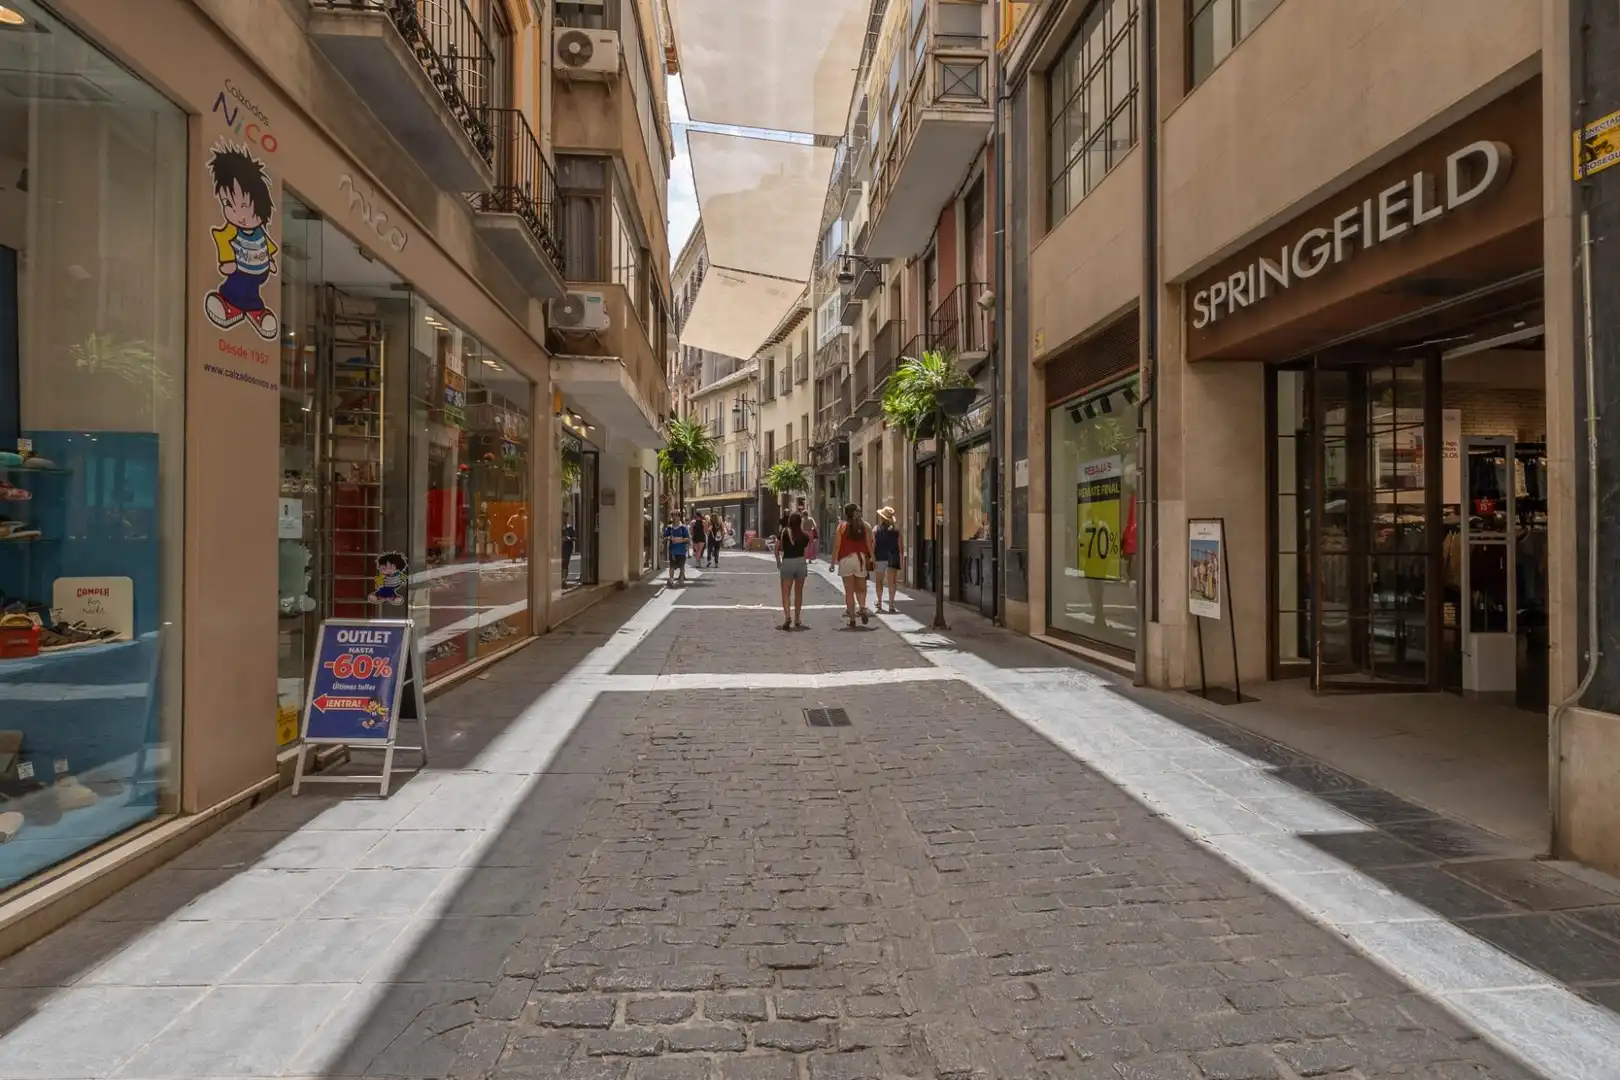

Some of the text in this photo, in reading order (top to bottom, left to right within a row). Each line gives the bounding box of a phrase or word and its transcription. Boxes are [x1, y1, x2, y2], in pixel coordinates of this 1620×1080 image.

[223, 78, 269, 127] Calzados
[1193, 140, 1512, 330] SPRINGFIELD
[218, 338, 248, 358] Desde
[1084, 462, 1113, 477] REBAJAS
[1101, 483, 1120, 495] FINAL
[1079, 526, 1119, 560] -70%
[76, 587, 110, 598] CAMPER
[336, 630, 392, 644] OUTLET
[323, 653, 393, 680] -60%
[326, 699, 361, 708] ¡ENTRA!
